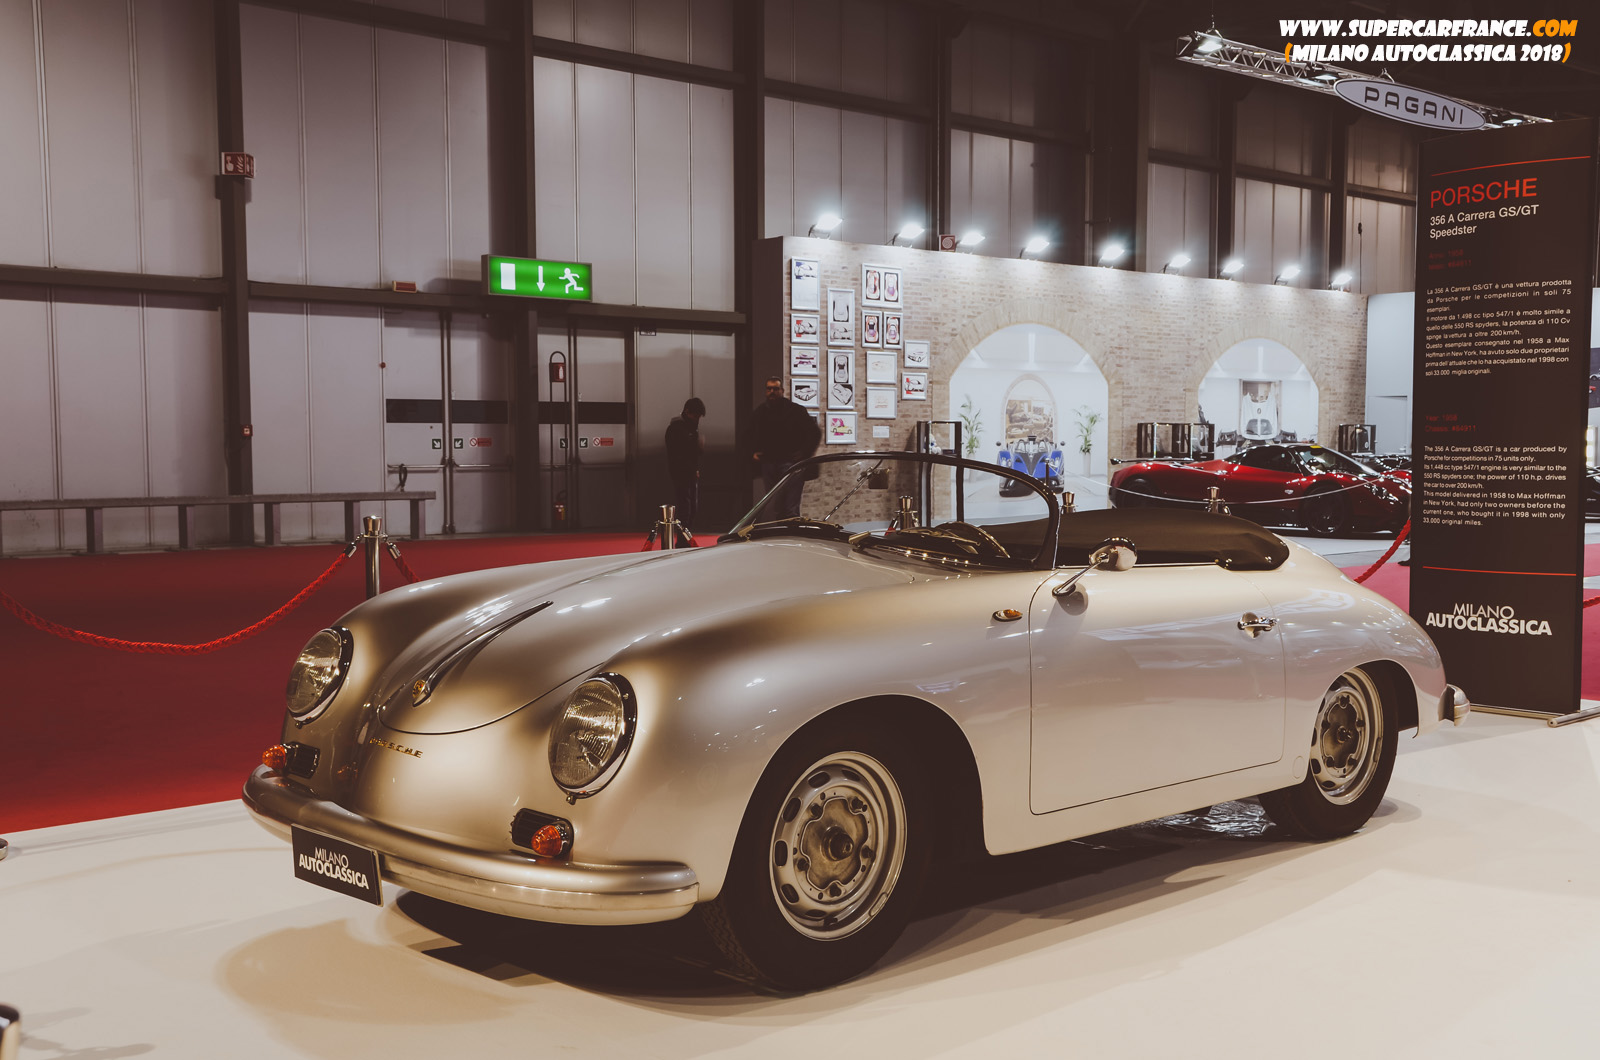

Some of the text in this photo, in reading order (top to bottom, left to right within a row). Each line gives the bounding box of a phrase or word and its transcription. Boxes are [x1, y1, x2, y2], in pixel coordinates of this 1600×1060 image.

[1364, 86, 1464, 125] PAGANI
[1430, 178, 1538, 208] PORSCHE
[1430, 205, 1539, 226] 356 A Carrera GS/GT
[1430, 224, 1477, 240] Speedster
[1484, 291, 1528, 299] competizioni
[1453, 603, 1514, 620] MILANO
[1426, 612, 1552, 636] AUTOCLASSICA
[314, 847, 348, 868] MILANO
[300, 854, 369, 889] AUTOCLASSICA
